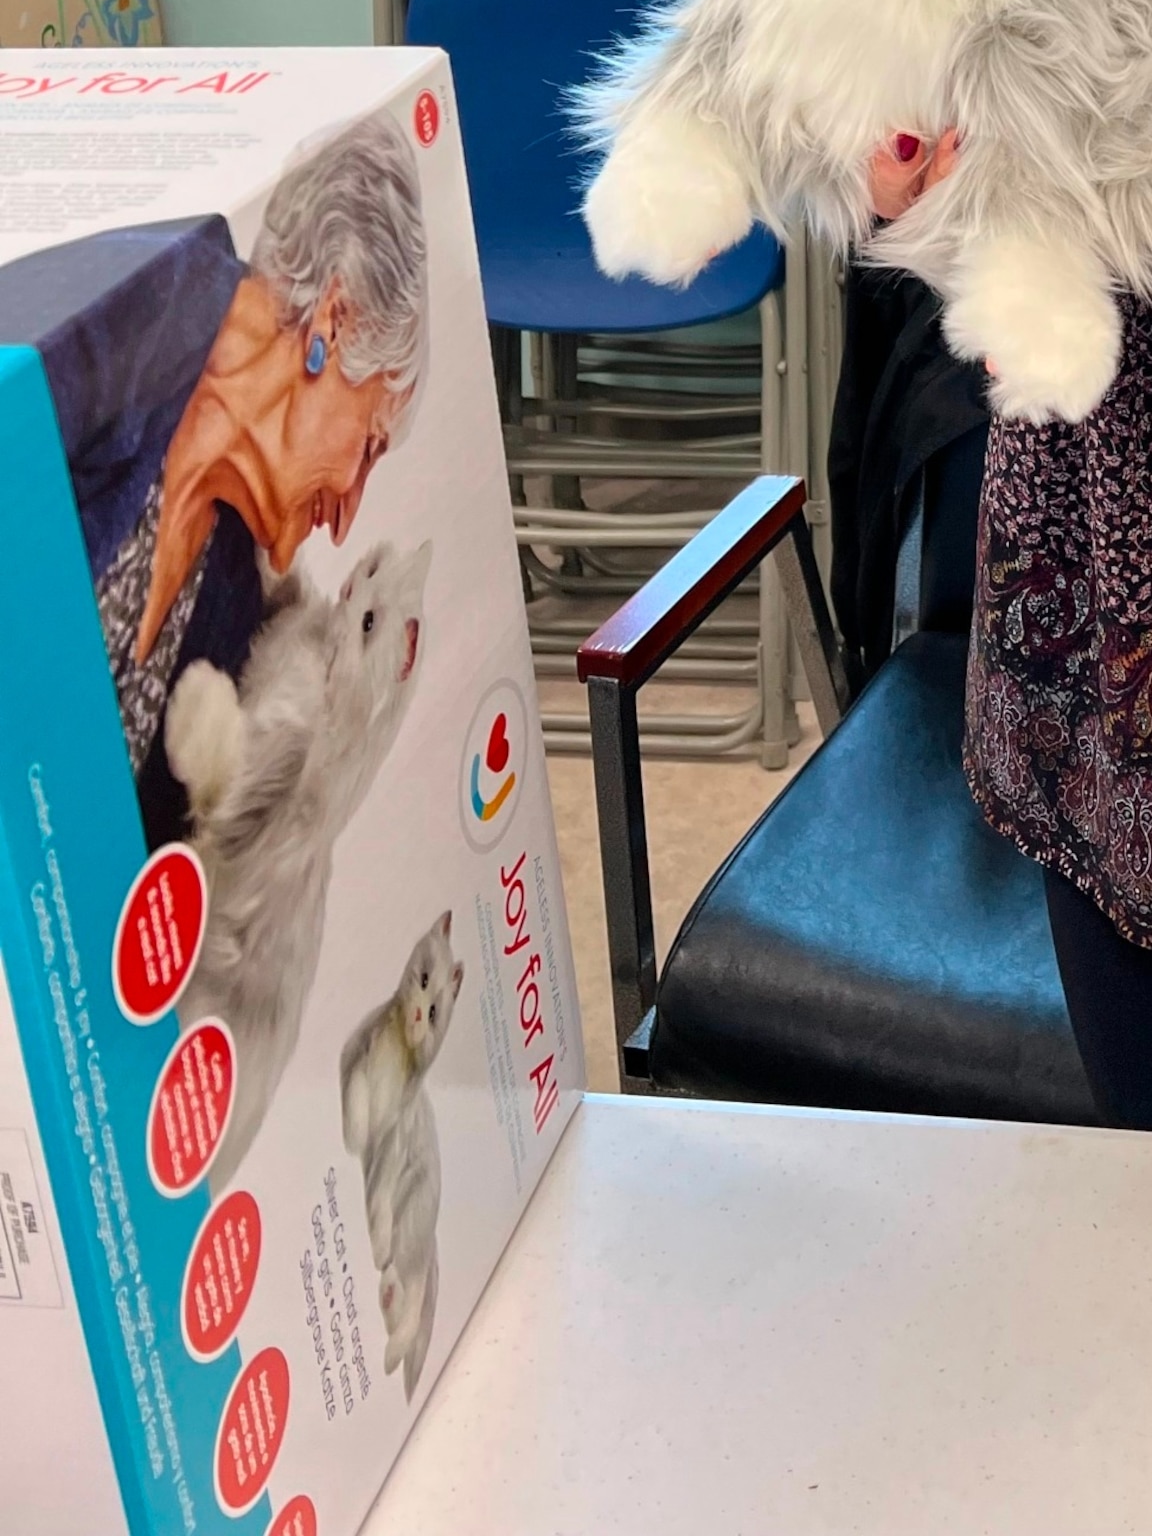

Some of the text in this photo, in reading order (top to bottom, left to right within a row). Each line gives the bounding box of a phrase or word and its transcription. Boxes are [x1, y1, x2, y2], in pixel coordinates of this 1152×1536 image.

[0, 71, 271, 99] oy for All
[500, 851, 559, 1135] Joy for All
[533, 855, 568, 1063] AGELESS INNOVATION'S
[300, 1248, 336, 1421] Silbergraue Katze
[311, 1204, 354, 1416] Gato gris Gato cinza
[323, 1166, 371, 1400] Silver Cat Chat argenté
